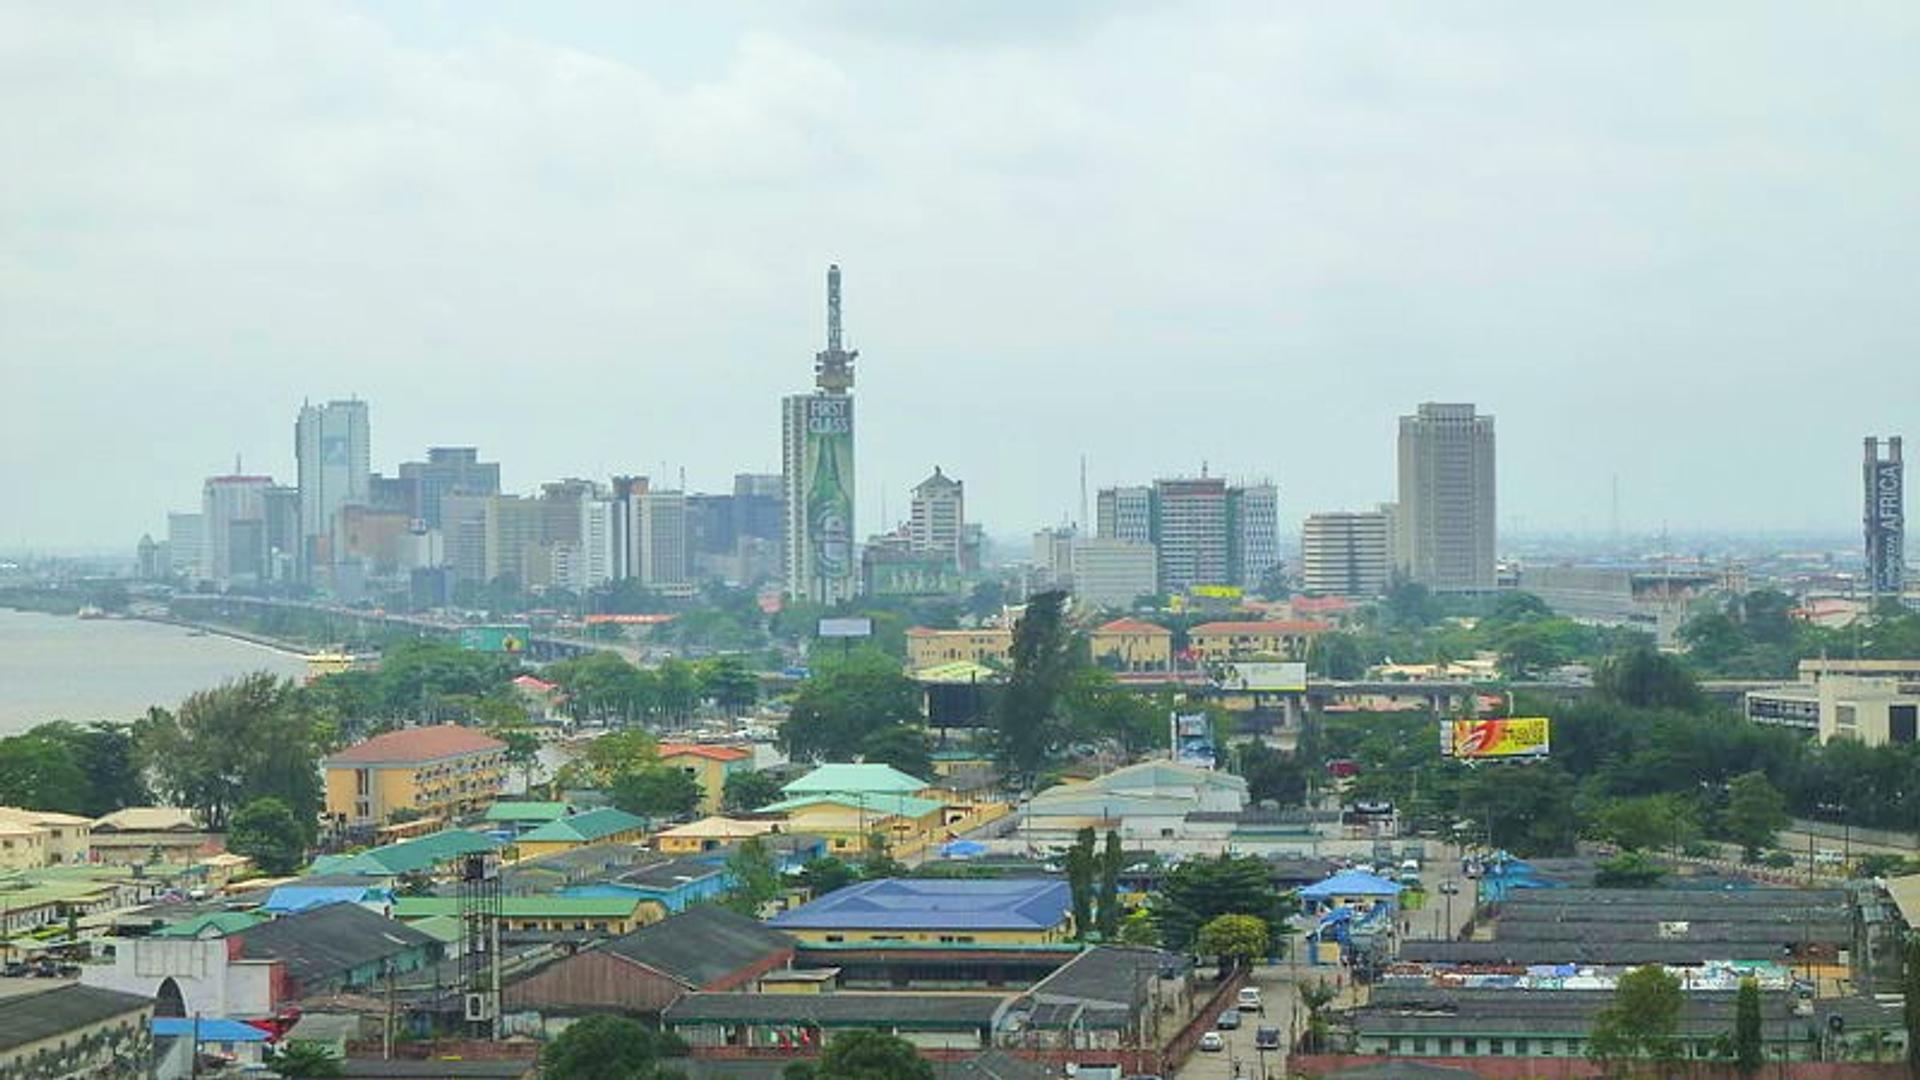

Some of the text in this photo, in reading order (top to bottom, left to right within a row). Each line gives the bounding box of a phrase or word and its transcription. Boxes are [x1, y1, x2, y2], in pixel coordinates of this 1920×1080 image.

[811, 400, 846, 417] FIRST
[809, 417, 849, 433] CLASS
[1879, 465, 1899, 533] AFRICA
